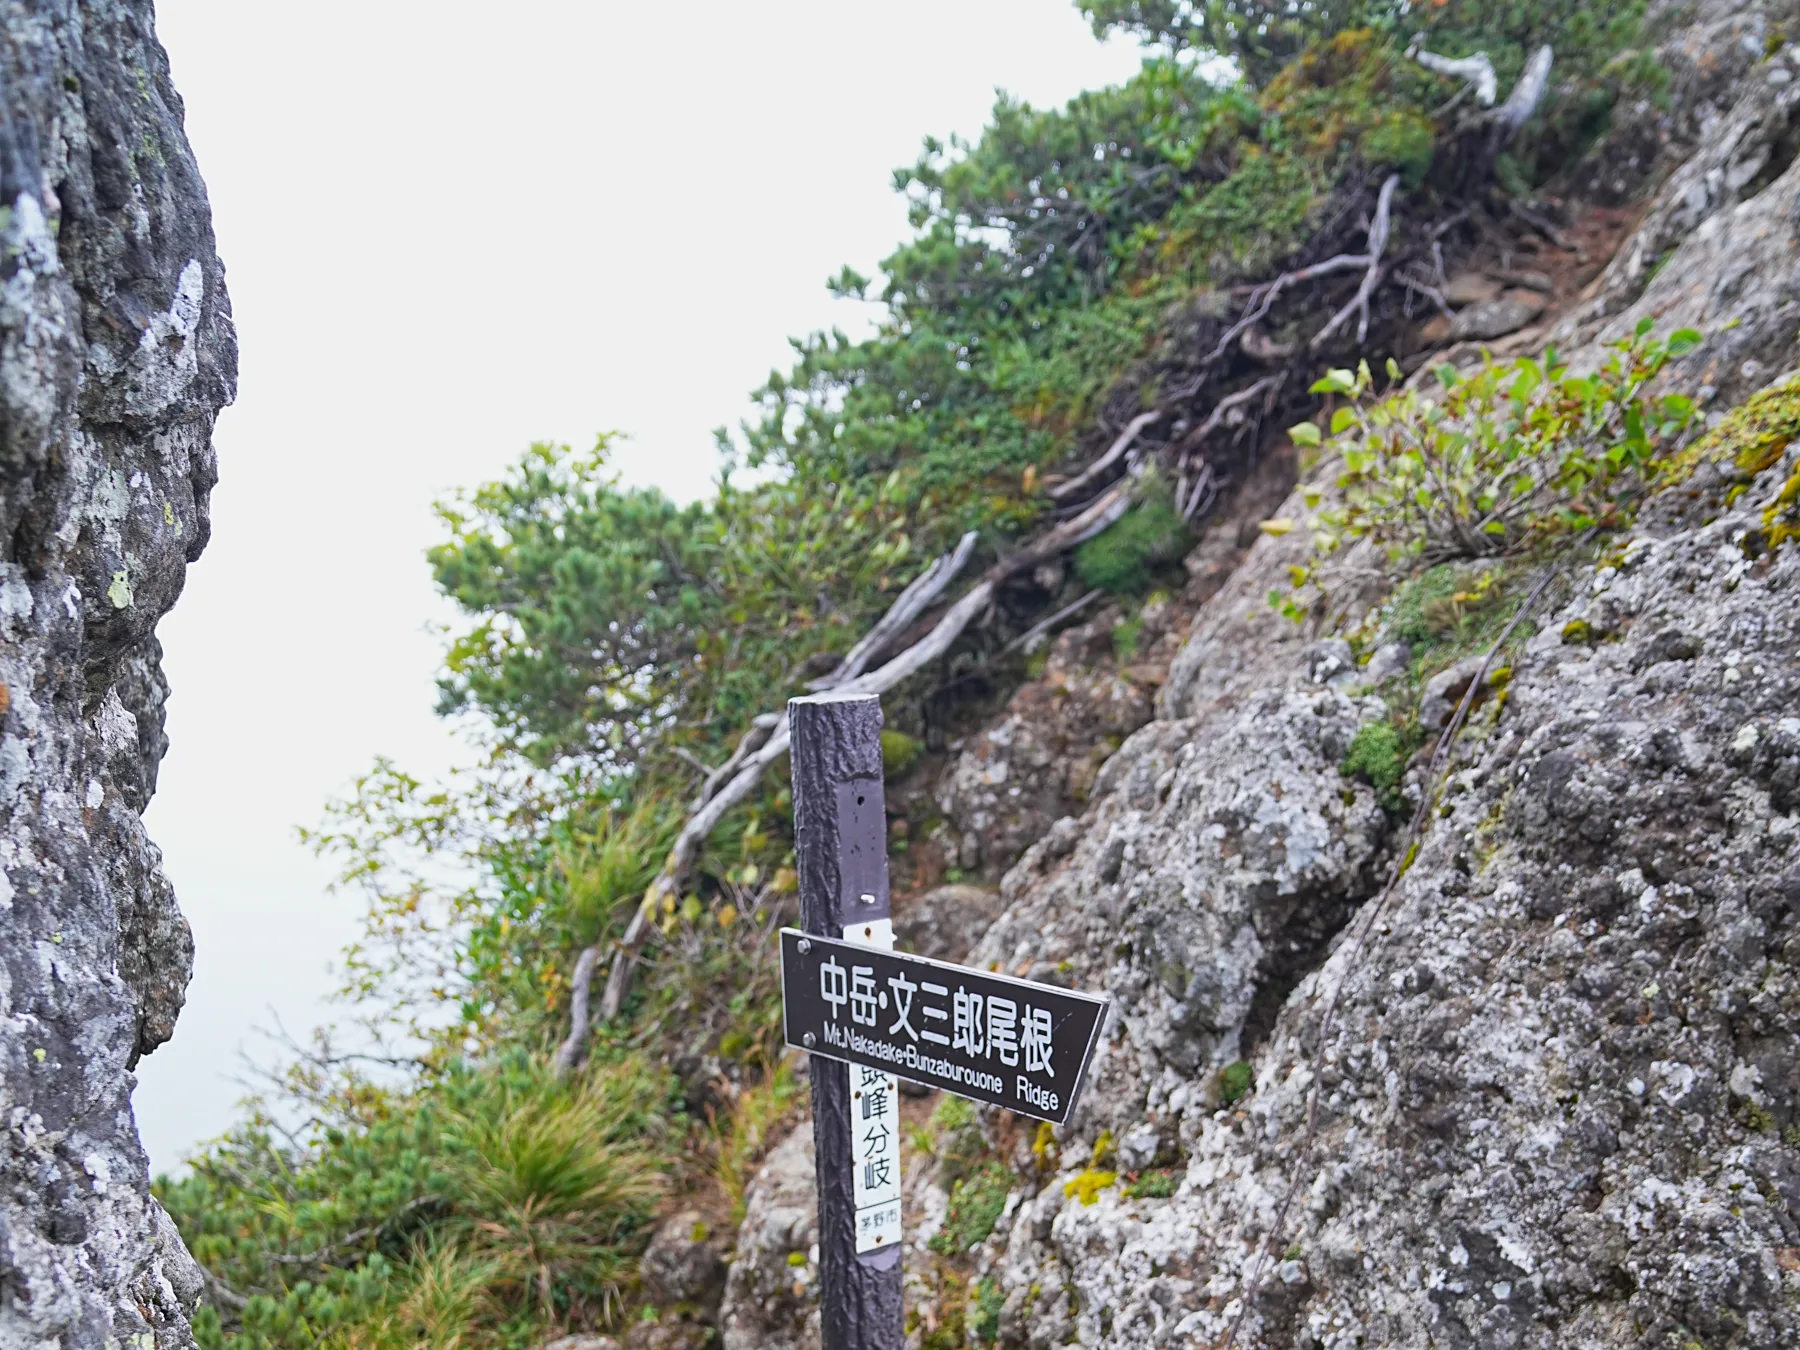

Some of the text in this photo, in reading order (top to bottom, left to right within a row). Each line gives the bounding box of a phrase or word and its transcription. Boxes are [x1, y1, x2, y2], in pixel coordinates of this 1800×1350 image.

[820, 955, 1055, 1078] 中岳・文三郎尾根
[1016, 1075, 1060, 1111] Ridge
